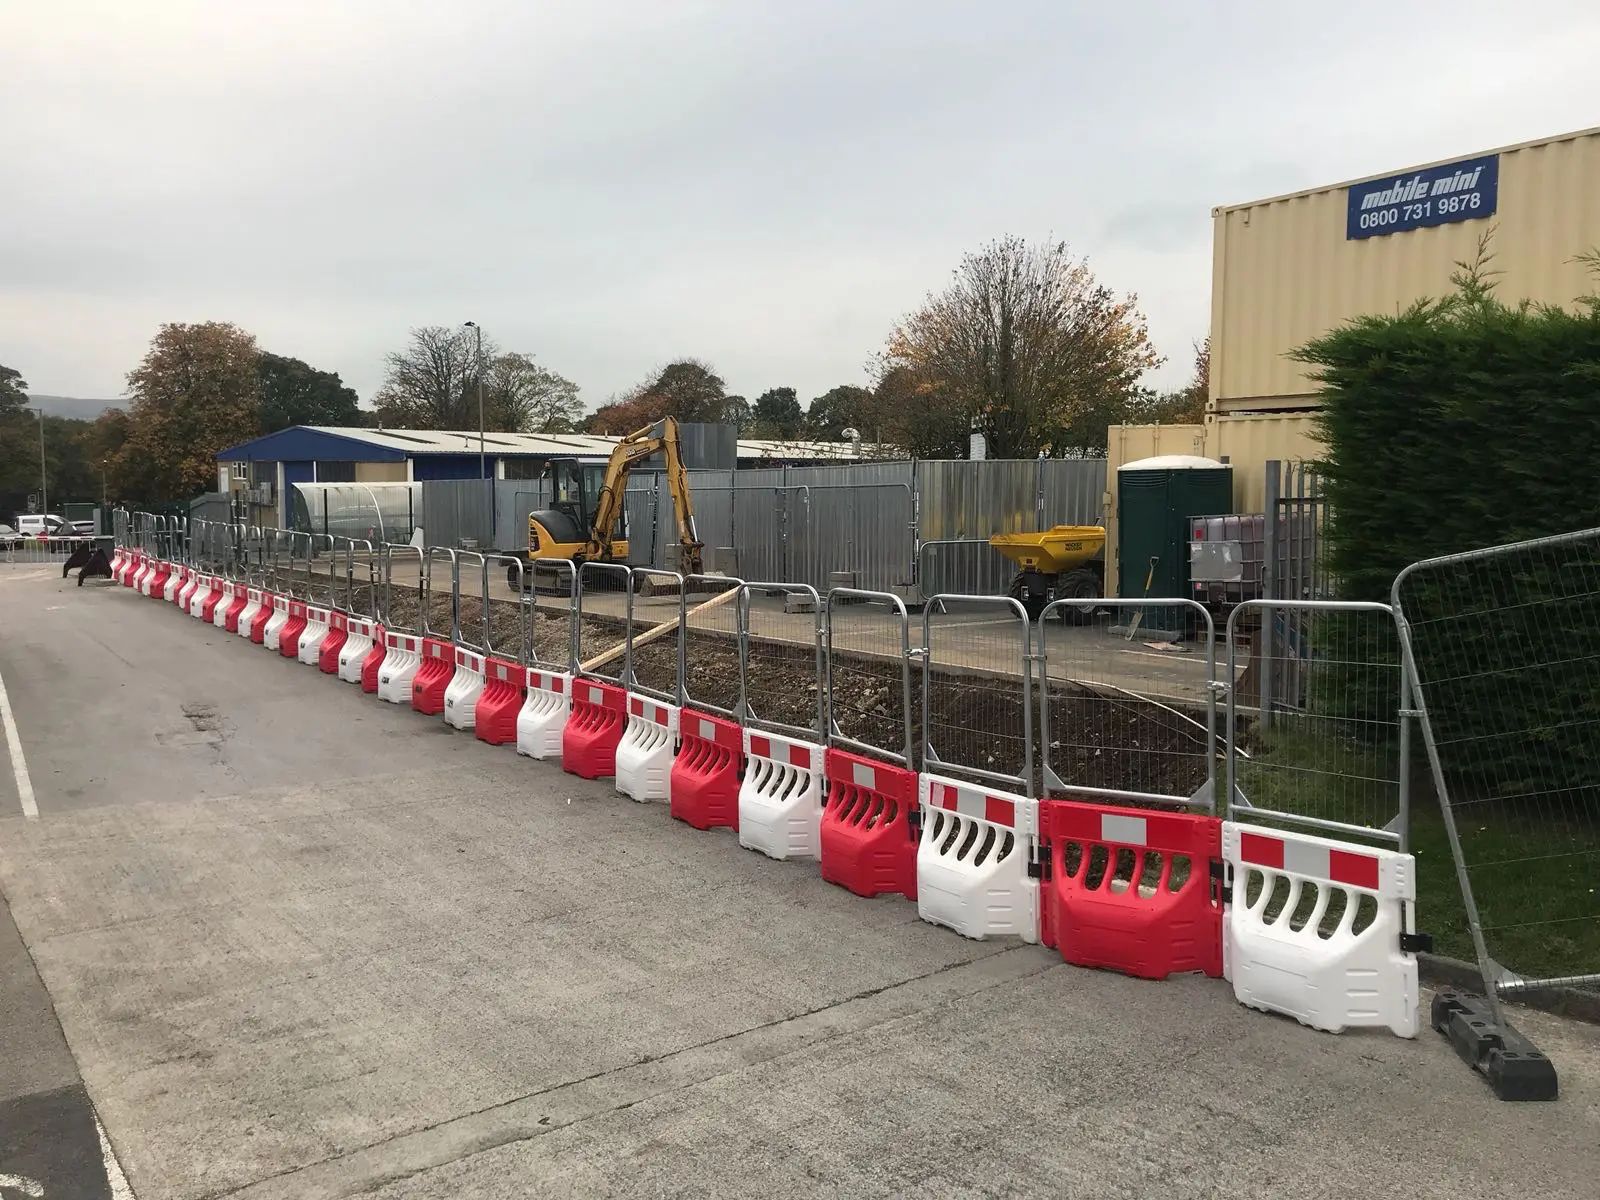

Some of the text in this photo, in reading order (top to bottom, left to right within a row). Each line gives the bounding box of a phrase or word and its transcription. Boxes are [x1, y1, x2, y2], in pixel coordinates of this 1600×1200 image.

[1361, 166, 1483, 210] mobile mini
[1360, 192, 1481, 229] 0800 731 9878
